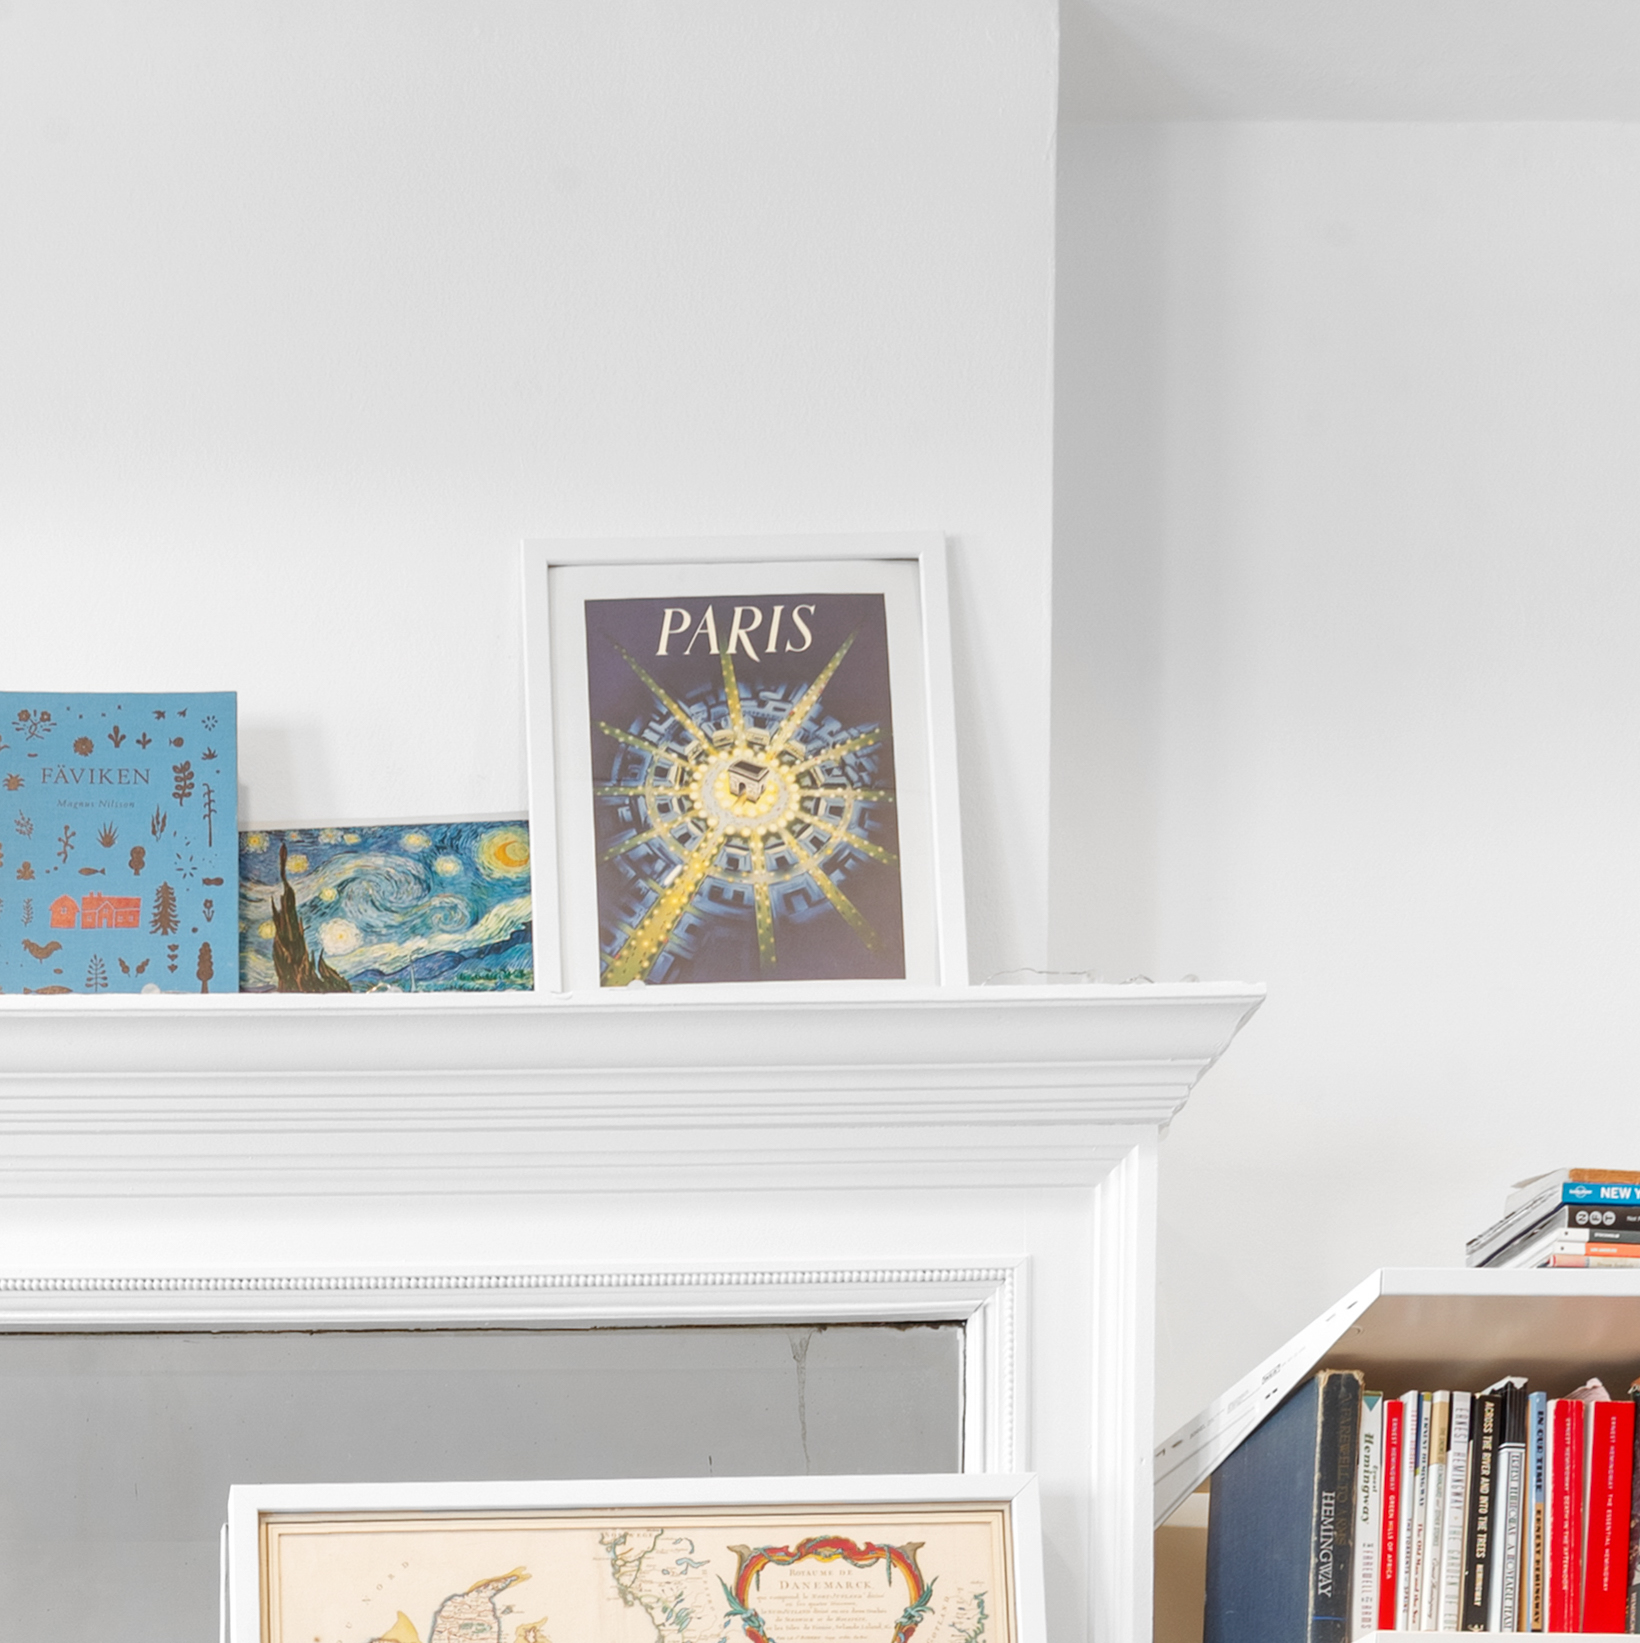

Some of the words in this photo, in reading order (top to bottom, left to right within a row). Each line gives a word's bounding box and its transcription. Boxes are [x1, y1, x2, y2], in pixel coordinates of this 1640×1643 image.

[656, 604, 816, 662] PARIS
[41, 766, 151, 786] FÄVIKEN
[56, 798, 95, 810] Magnus
[99, 798, 135, 809] Nilsson
[1600, 1187, 1632, 1199] NEW
[1537, 1411, 1544, 1425] IN
[1536, 1429, 1544, 1453] OUR
[1360, 1433, 1374, 1524] Hemingway
[1317, 1491, 1335, 1598] HEMINGWAY
